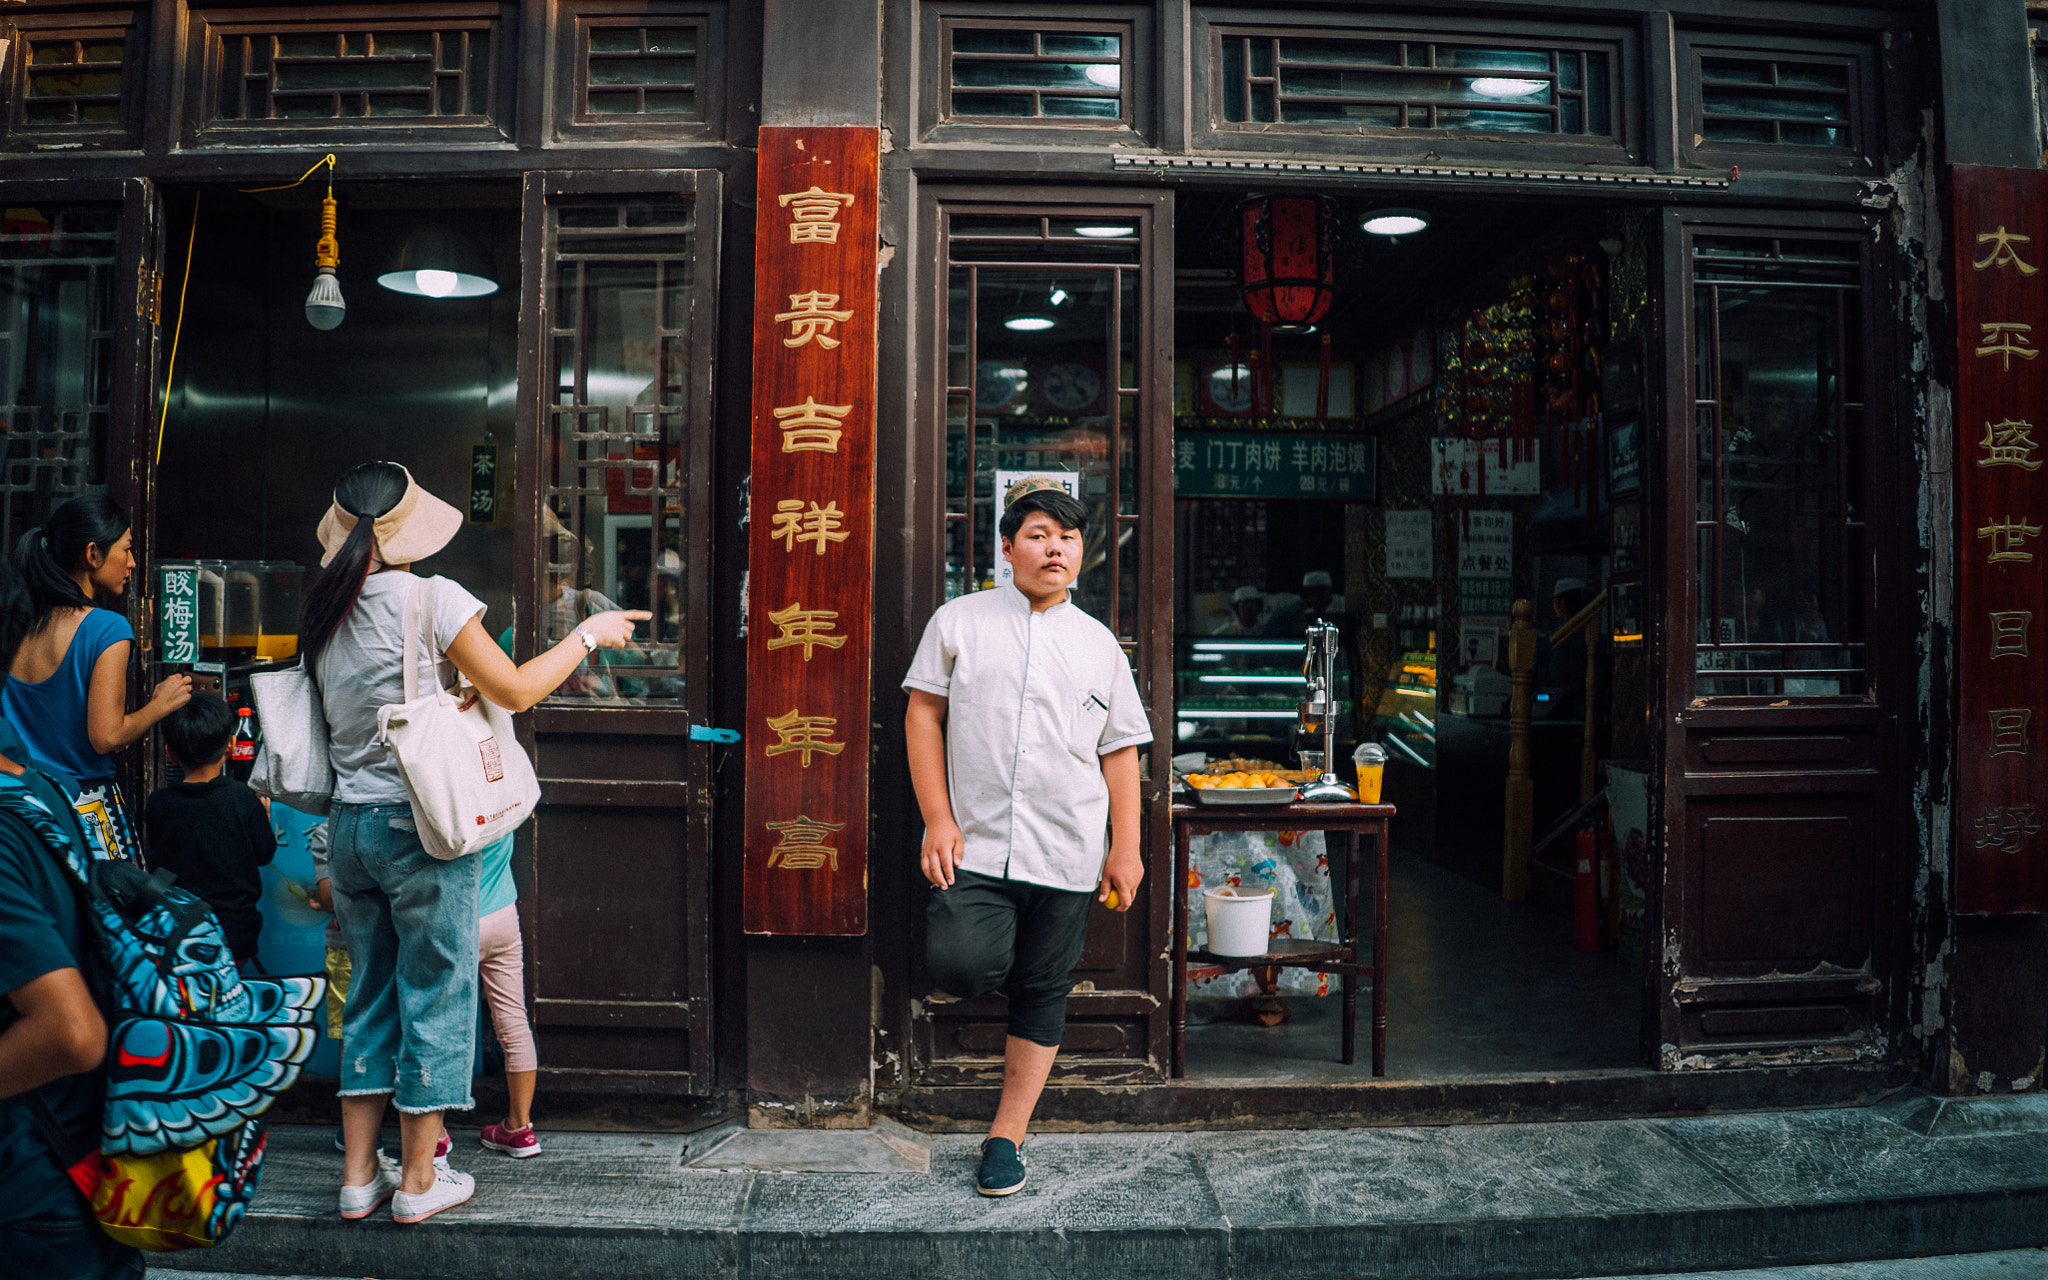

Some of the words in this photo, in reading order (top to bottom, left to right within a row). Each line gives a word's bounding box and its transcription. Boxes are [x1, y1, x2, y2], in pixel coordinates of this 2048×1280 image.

[1174, 438, 1197, 470] 麦
[1206, 438, 1282, 472] 门丁肉饼
[1290, 440, 1367, 474] 羊肉泡馍
[470, 452, 495, 513] 茶汤
[766, 185, 855, 871] 富贵吉祥年年高
[1972, 224, 2044, 854] 太平盛世日日好
[1461, 554, 1510, 572] 点餐处
[163, 570, 195, 661] 酸梅汤
